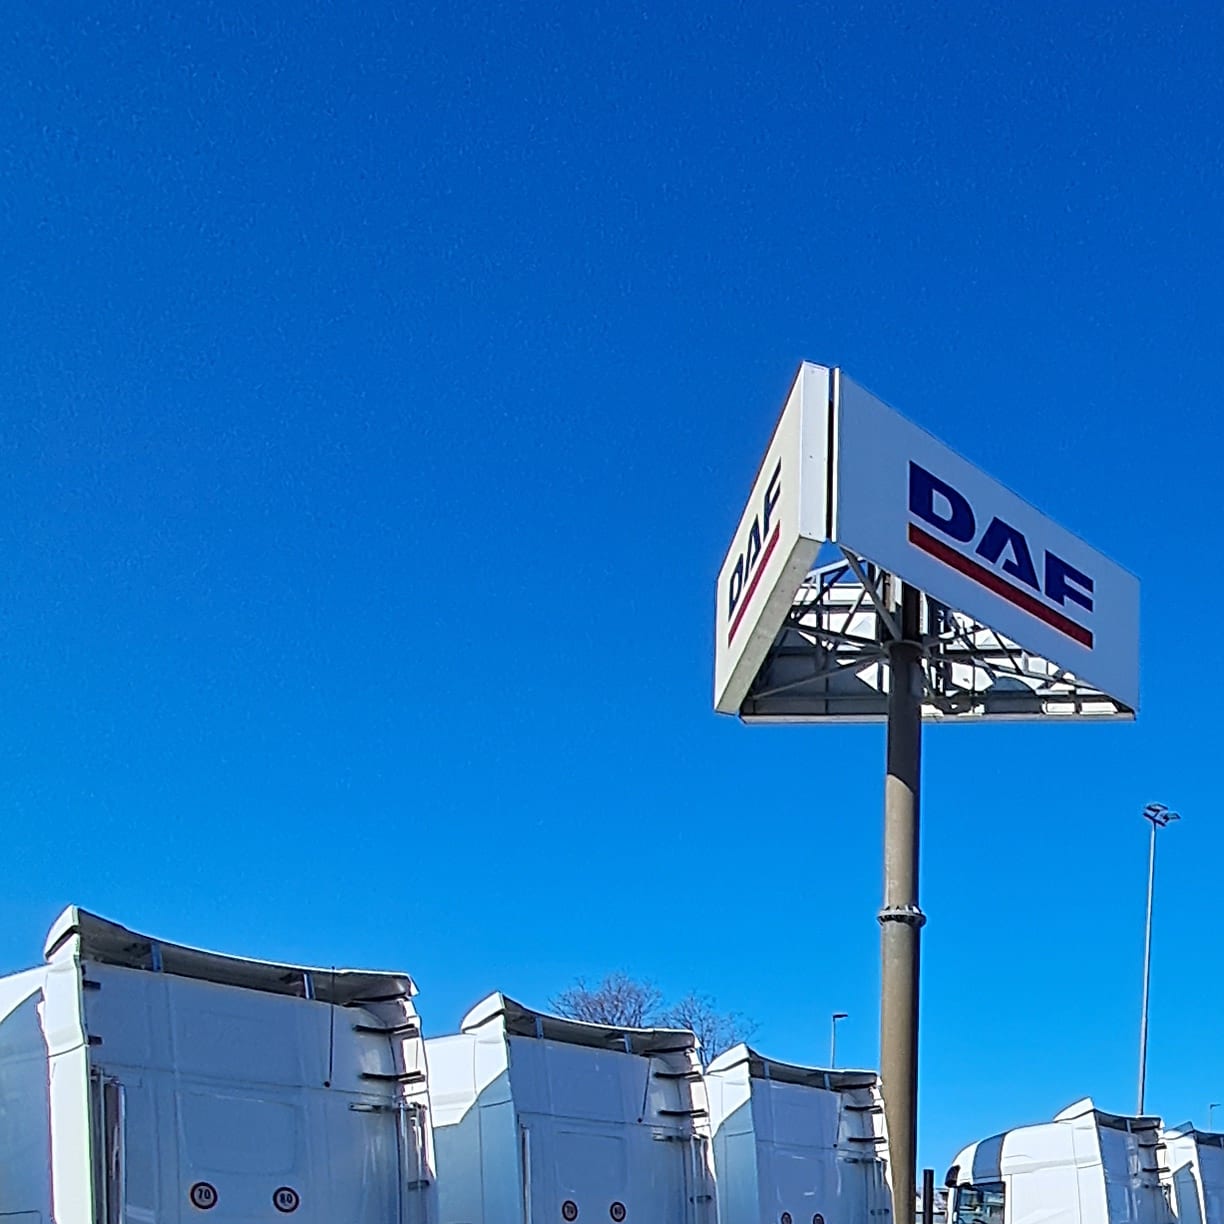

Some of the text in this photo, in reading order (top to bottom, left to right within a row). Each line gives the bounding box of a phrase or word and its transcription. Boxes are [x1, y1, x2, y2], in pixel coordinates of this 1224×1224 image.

[728, 455, 782, 624] DAF
[908, 459, 1094, 613] DAF
[198, 1188, 211, 1200] 70
[279, 1193, 293, 1204] 80
